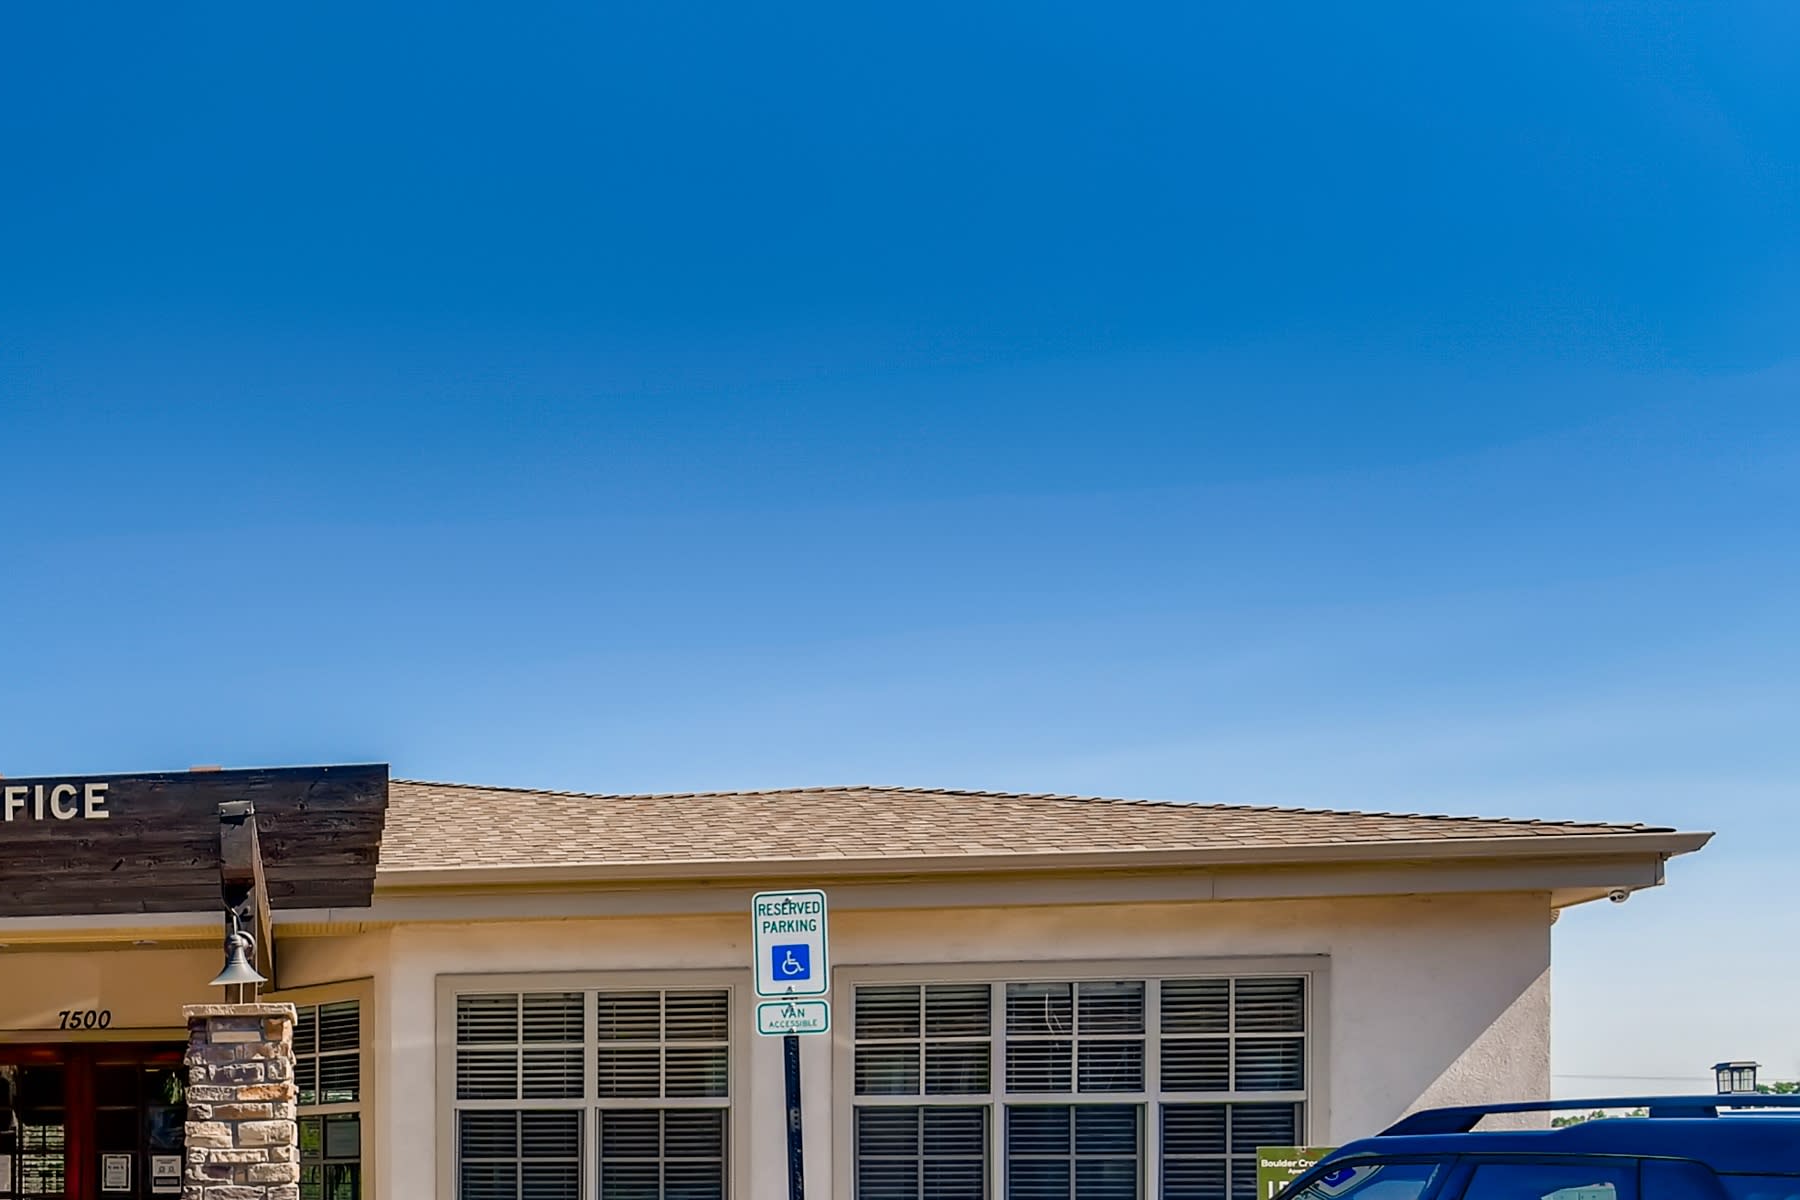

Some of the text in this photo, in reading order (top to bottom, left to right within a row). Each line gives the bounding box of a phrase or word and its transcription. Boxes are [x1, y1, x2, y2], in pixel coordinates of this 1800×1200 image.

[758, 900, 821, 917] RESERVED
[762, 918, 817, 934] PARKING
[58, 1009, 112, 1030] 7500
[781, 1007, 806, 1019] VAN
[768, 1018, 818, 1029] ACCESSIBLE
[1260, 1159, 1297, 1168] Boulder
